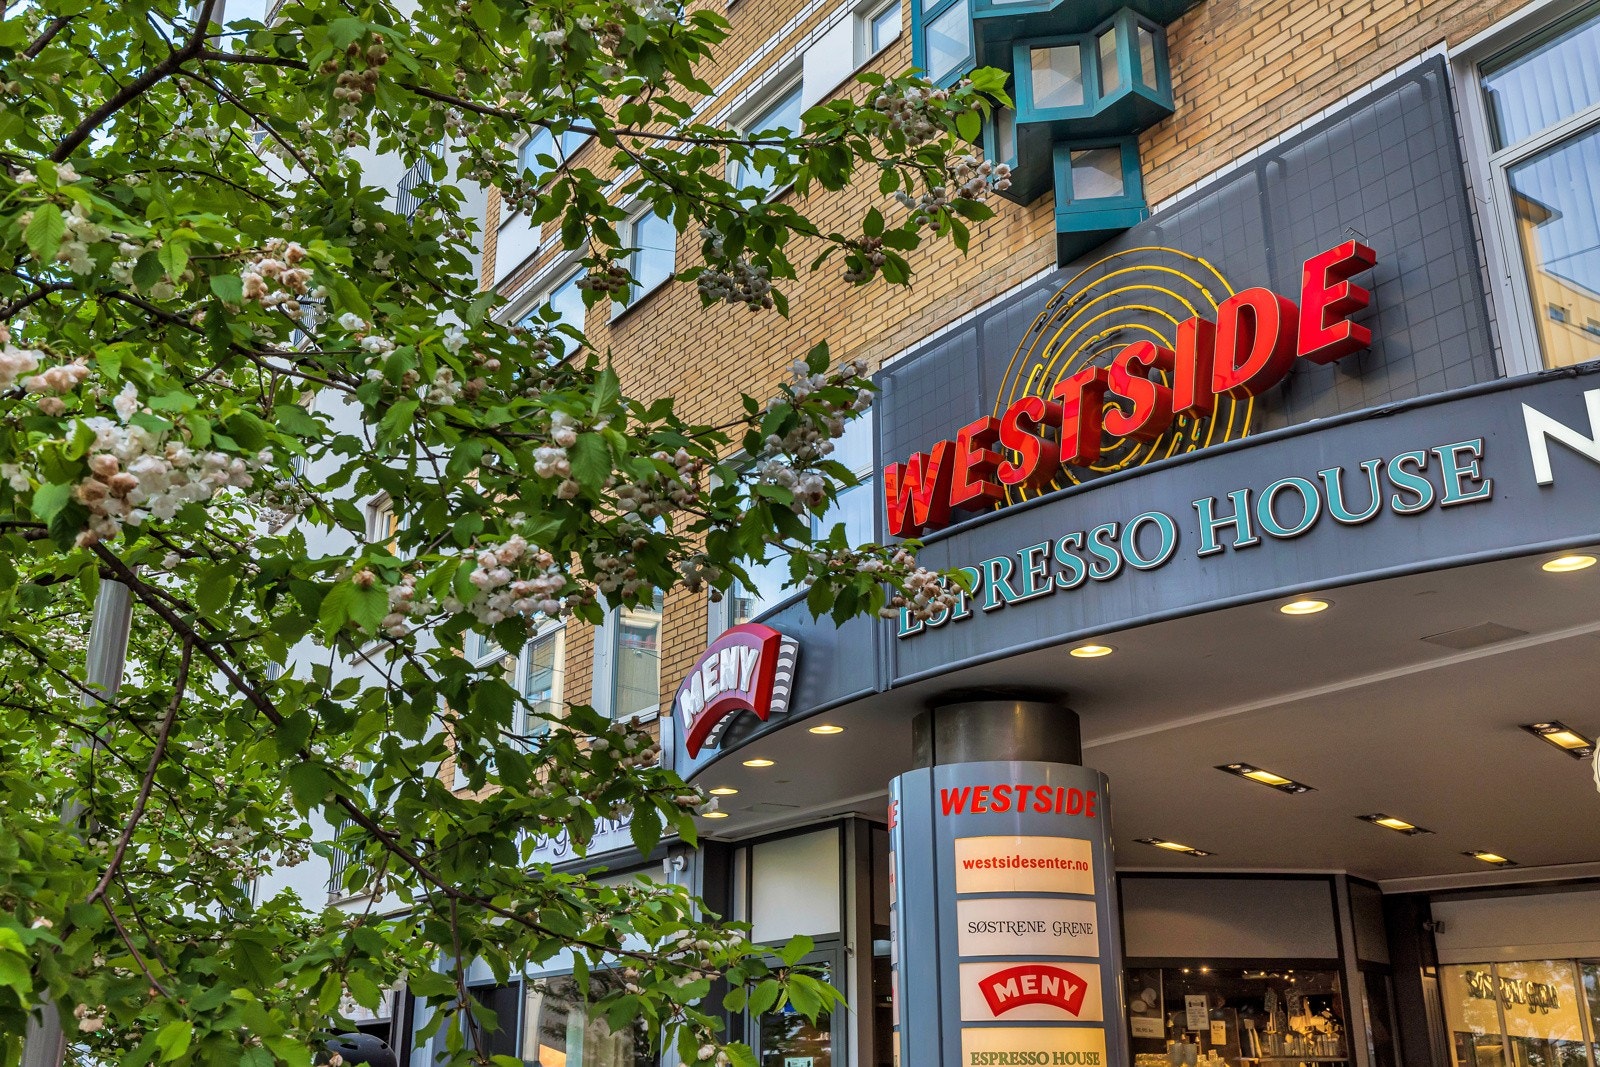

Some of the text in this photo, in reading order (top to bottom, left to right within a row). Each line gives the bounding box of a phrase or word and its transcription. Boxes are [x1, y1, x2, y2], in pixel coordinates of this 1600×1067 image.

[884, 238, 1376, 538] WESTSIDE
[1192, 436, 1494, 558] HOUSE
[680, 645, 760, 730] MENY
[940, 784, 1098, 818] WESTSIDE
[963, 854, 1089, 872] westsidesenter.no
[968, 920, 1093, 938] SØSTRENE GRENE
[992, 974, 1079, 1003] MENY
[970, 1051, 1100, 1066] ESPRESSO HOUSE
